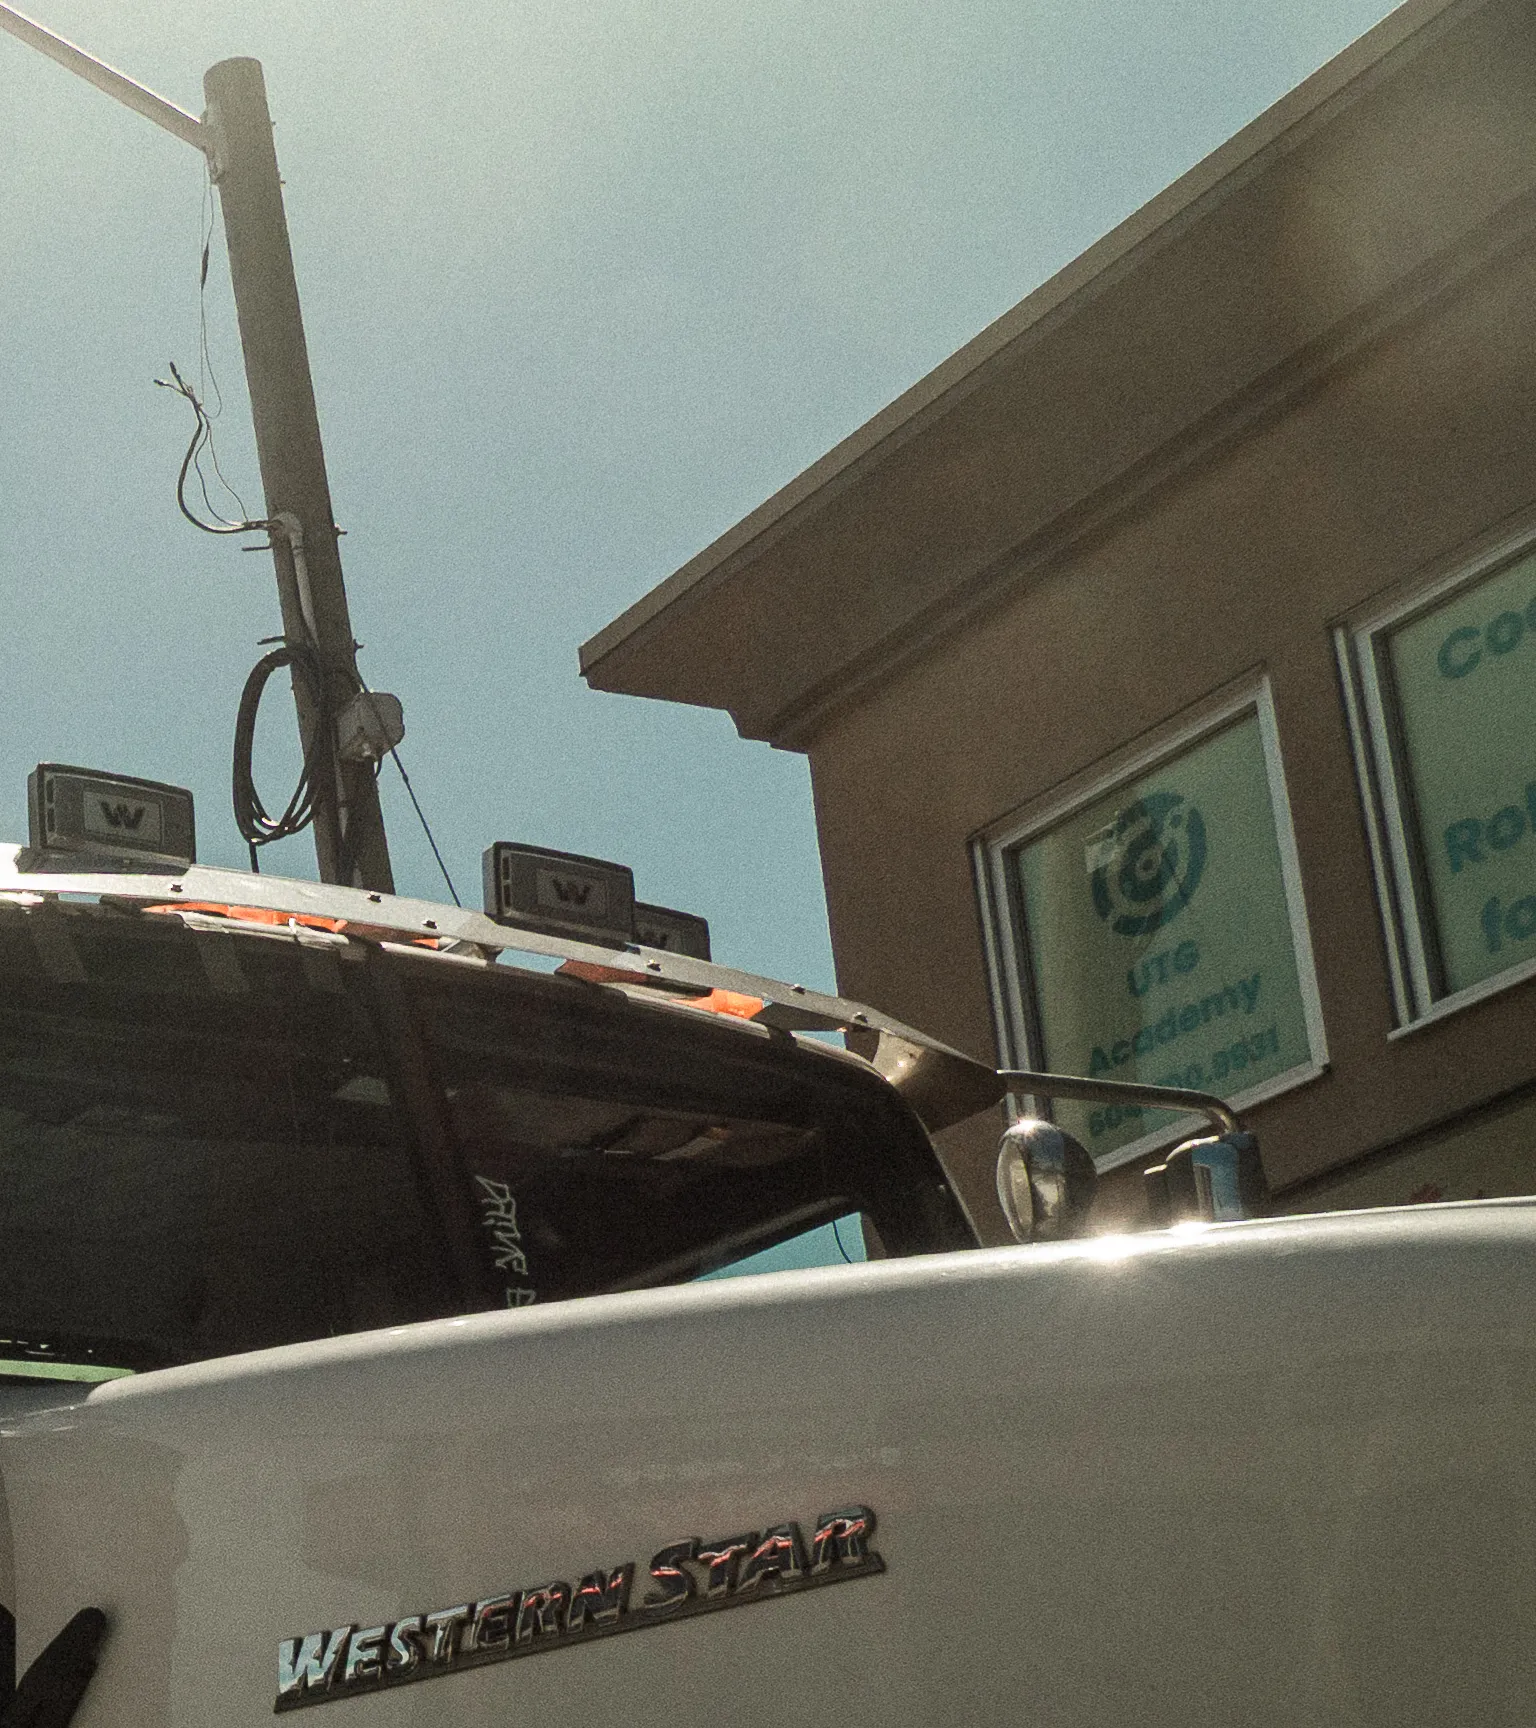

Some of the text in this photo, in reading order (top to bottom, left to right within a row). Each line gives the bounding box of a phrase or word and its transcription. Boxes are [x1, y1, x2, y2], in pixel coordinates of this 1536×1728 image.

[1437, 598, 1536, 680] Co
[1443, 781, 1536, 874] Ro
[1089, 974, 1261, 1076] Academy
[277, 1503, 882, 1702] WESTERN STAR
